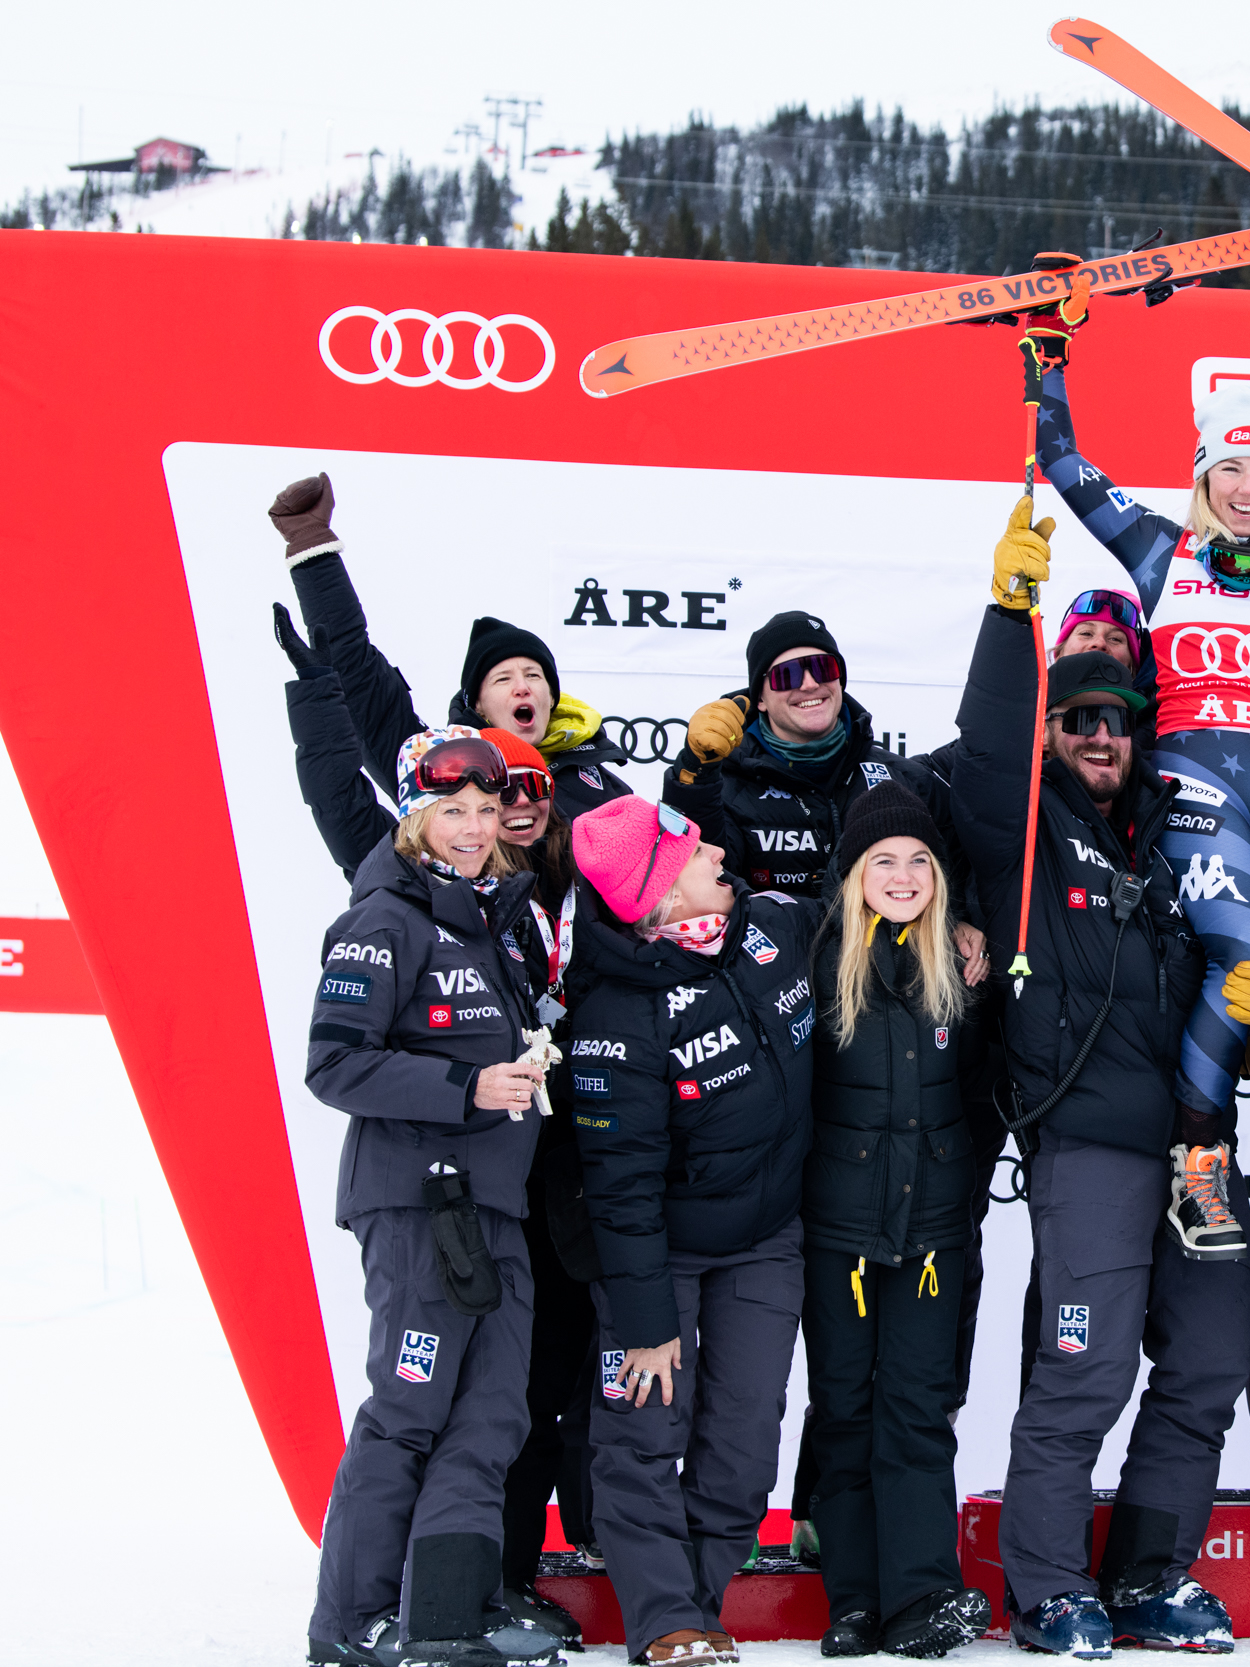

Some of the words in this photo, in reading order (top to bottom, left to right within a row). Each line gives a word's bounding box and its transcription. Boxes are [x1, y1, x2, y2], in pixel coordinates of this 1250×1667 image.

[957, 287, 995, 310] 86
[1003, 254, 1172, 302] VICTORIES
[563, 577, 727, 631] ÅRE
[861, 763, 888, 775] US
[1179, 783, 1218, 799] OYOTA
[750, 829, 818, 852] VISA
[774, 872, 809, 884] TOYO
[322, 978, 367, 998] STIFEL
[429, 967, 490, 996] VISA
[456, 1006, 502, 1021] TOYOTA
[571, 1039, 627, 1060] USANA
[668, 1024, 741, 1069] VISA
[574, 1074, 609, 1092] STIFEL
[702, 1062, 752, 1091] TOYOTA
[576, 1115, 591, 1126] BOSS
[592, 1119, 611, 1128] LADY
[1060, 1306, 1087, 1323] US
[405, 1332, 437, 1353] US
[416, 1350, 434, 1359] TEAM
[603, 1352, 624, 1368] US
